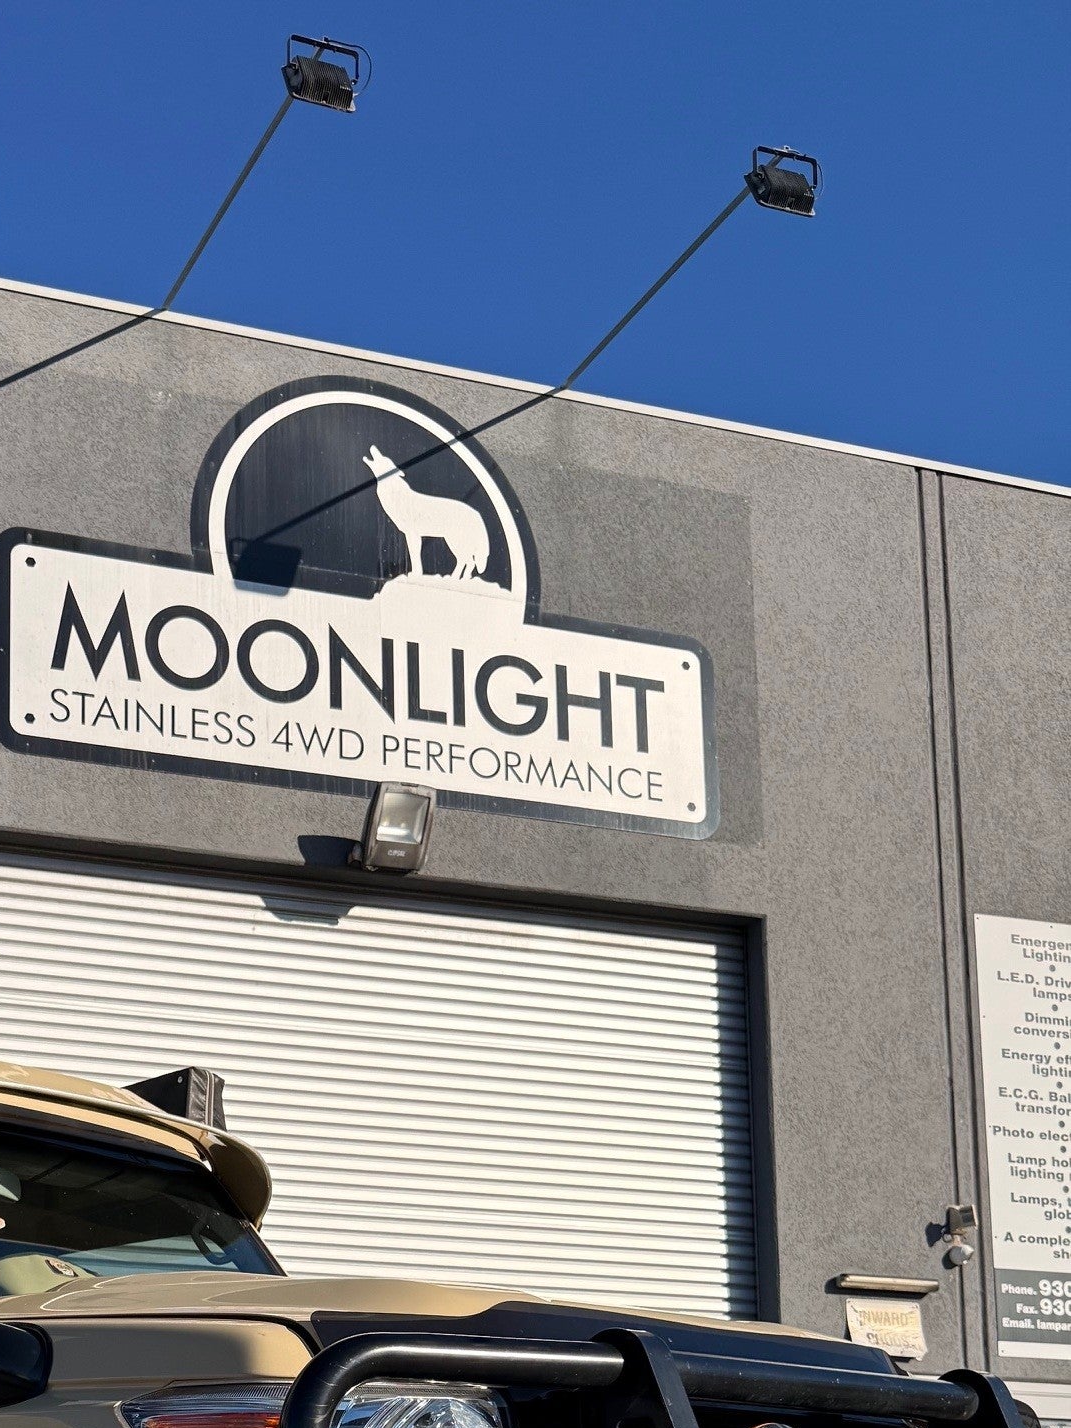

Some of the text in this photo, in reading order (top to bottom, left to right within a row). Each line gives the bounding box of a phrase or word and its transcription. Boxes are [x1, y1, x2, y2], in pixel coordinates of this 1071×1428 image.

[50, 579, 665, 754] MOONLIGHT
[48, 687, 665, 803] STAINLESS 4WD PERFORMANCE
[997, 970, 1040, 986] L.E.D.
[1024, 1012, 1071, 1027] Dimmi
[1001, 1048, 1051, 1065] Energy
[998, 1087, 1043, 1101] E.C.G.
[992, 1125, 1034, 1139] Photo
[1007, 1152, 1047, 1167] Lamp
[1010, 1165, 1065, 1182] lighting
[1010, 1192, 1062, 1208] Lamps,
[1004, 1231, 1014, 1242] A
[1053, 1248, 1071, 1260] sh
[1001, 1283, 1038, 1296] Phone.
[1015, 1303, 1039, 1315] Fax.
